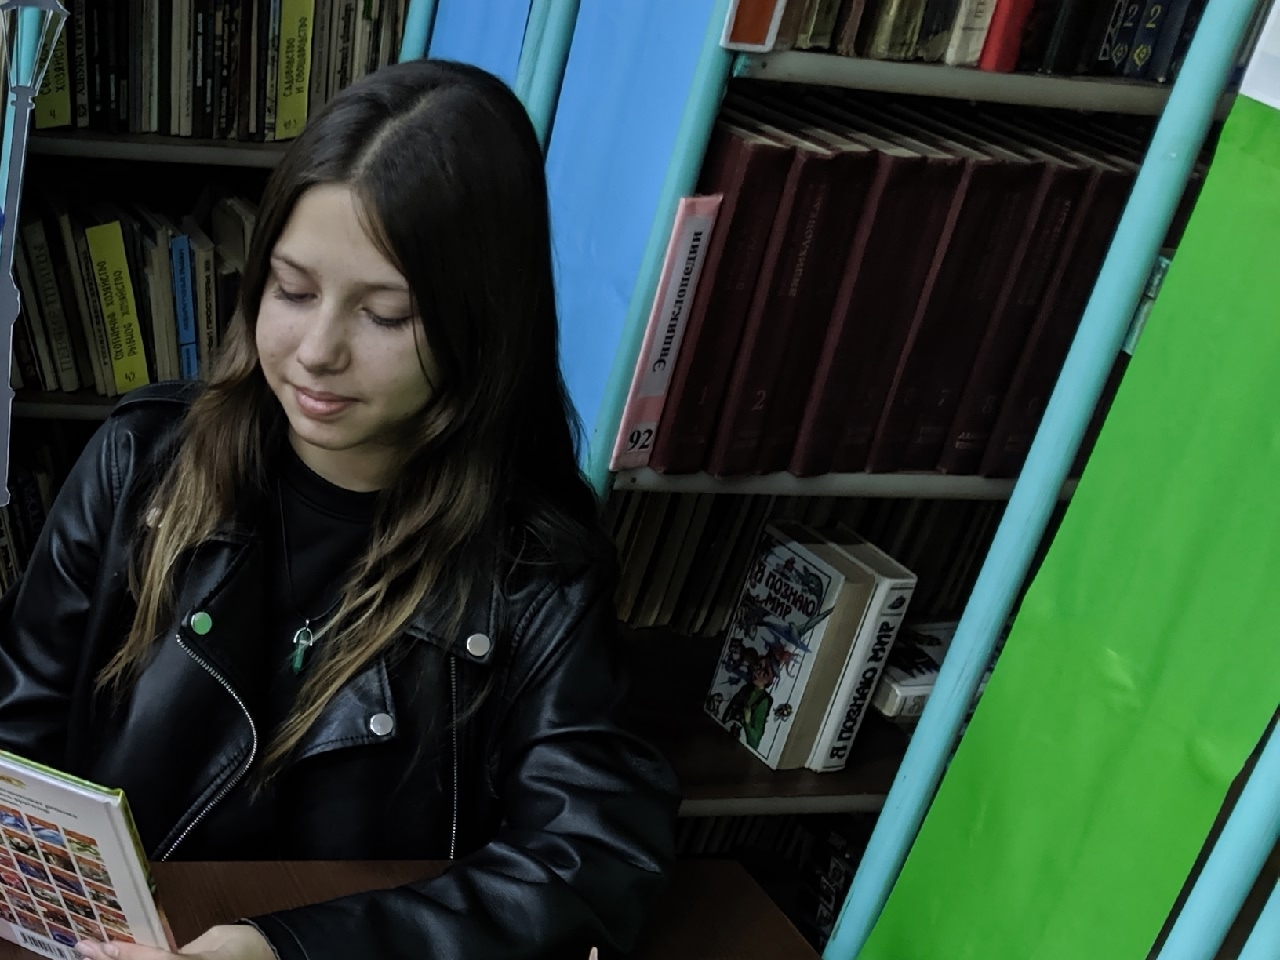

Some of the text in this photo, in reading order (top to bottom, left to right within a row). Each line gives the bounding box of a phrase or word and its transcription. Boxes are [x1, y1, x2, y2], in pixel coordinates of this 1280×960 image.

[1146, 4, 1160, 29] 2
[652, 229, 703, 374] Энциклопедии
[627, 428, 654, 453] 92
[829, 620, 895, 760] Я ПОЗНАЮ МИР
